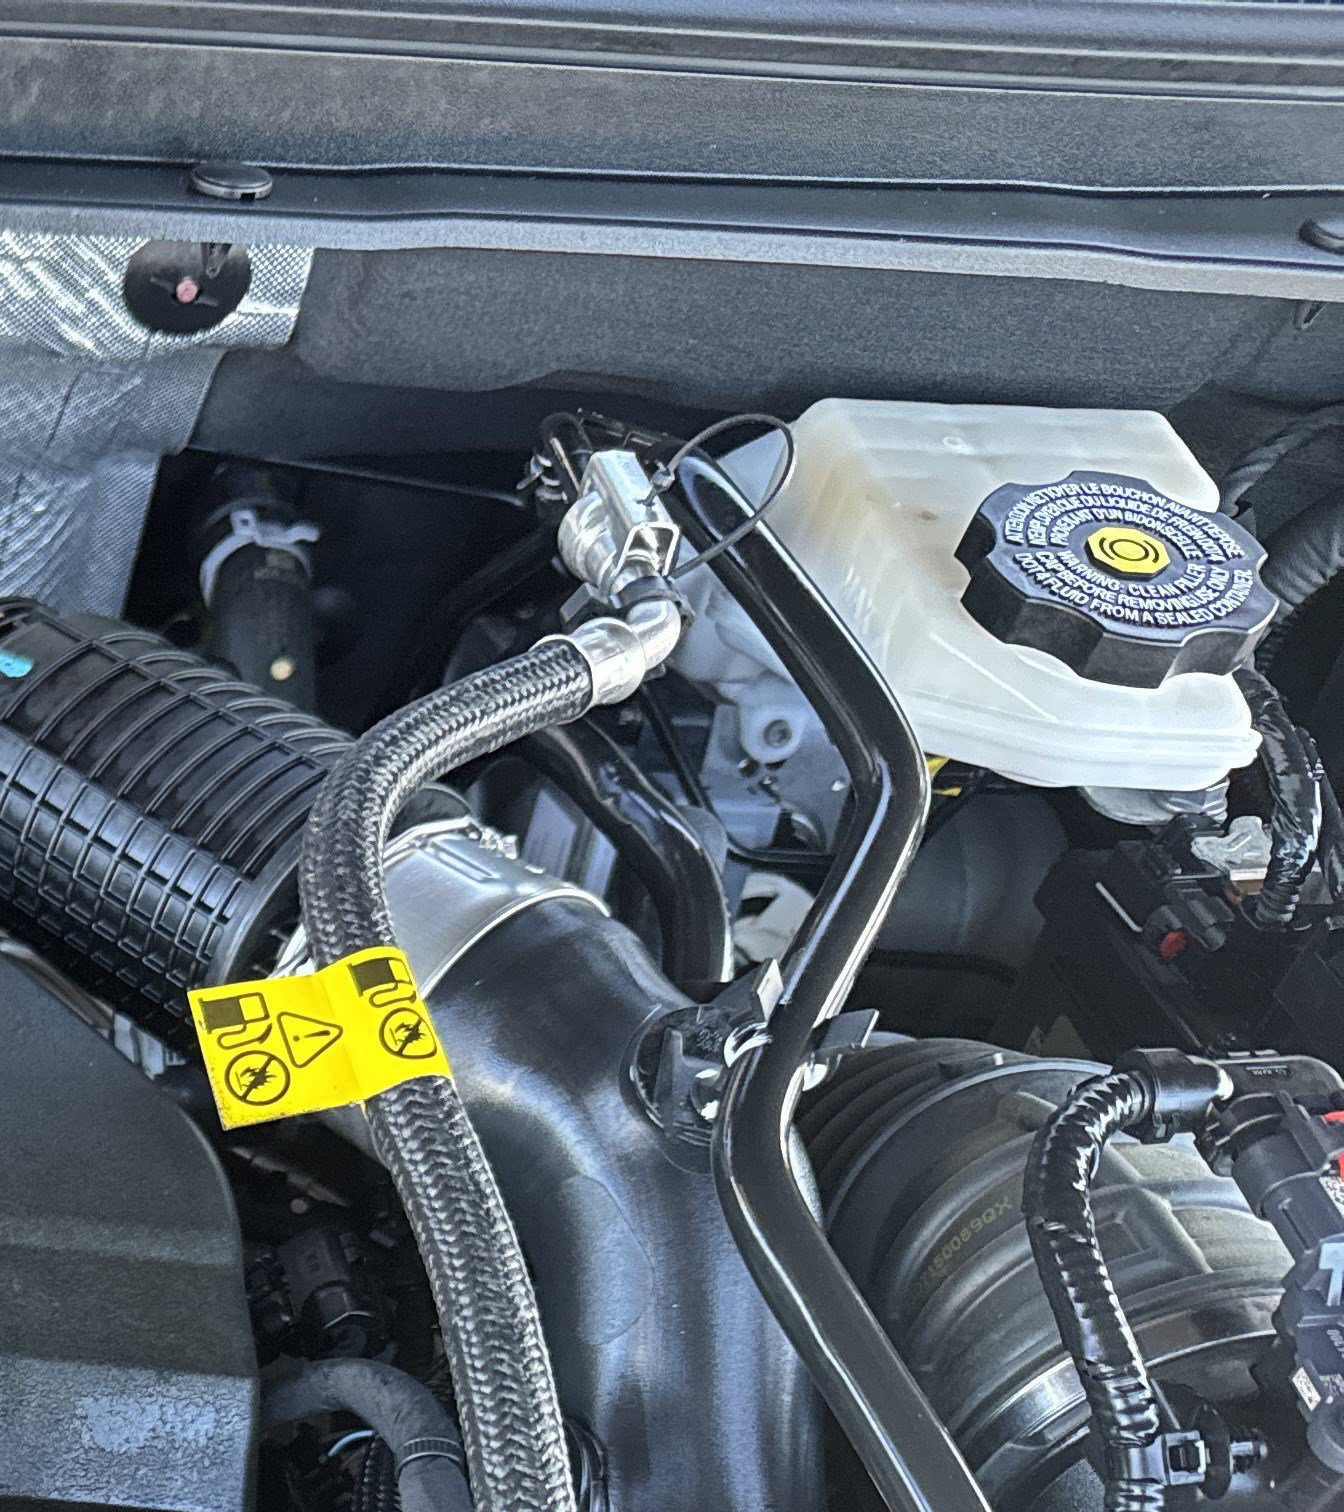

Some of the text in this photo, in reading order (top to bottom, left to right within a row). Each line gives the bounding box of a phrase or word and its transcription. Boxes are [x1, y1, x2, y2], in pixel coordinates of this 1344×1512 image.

[1056, 496, 1084, 511] QUE
[1079, 495, 1101, 507] DU
[1099, 496, 1152, 514] LIQUIDE
[1150, 507, 1172, 521] DE
[1168, 516, 1207, 539] FREIN
[1080, 483, 1101, 494] LE
[1100, 484, 1166, 507] BOUCHON
[1164, 502, 1211, 525] AVANT
[1091, 508, 1123, 520] D'UN
[1124, 511, 1165, 531] BIDON
[1035, 551, 1065, 571] CAP
[1057, 570, 1116, 603] BEFORE
[1189, 585, 1220, 604] USE
[1206, 565, 1230, 591] ONLY
[1058, 550, 1206, 597] WARNING: CLEAN FILLER
[1043, 577, 1089, 604] FLUID
[1090, 599, 1139, 621] FROM
[1142, 611, 1154, 624] A
[1155, 608, 1214, 625] SEALED
[1209, 569, 1253, 616] CONTAINER
